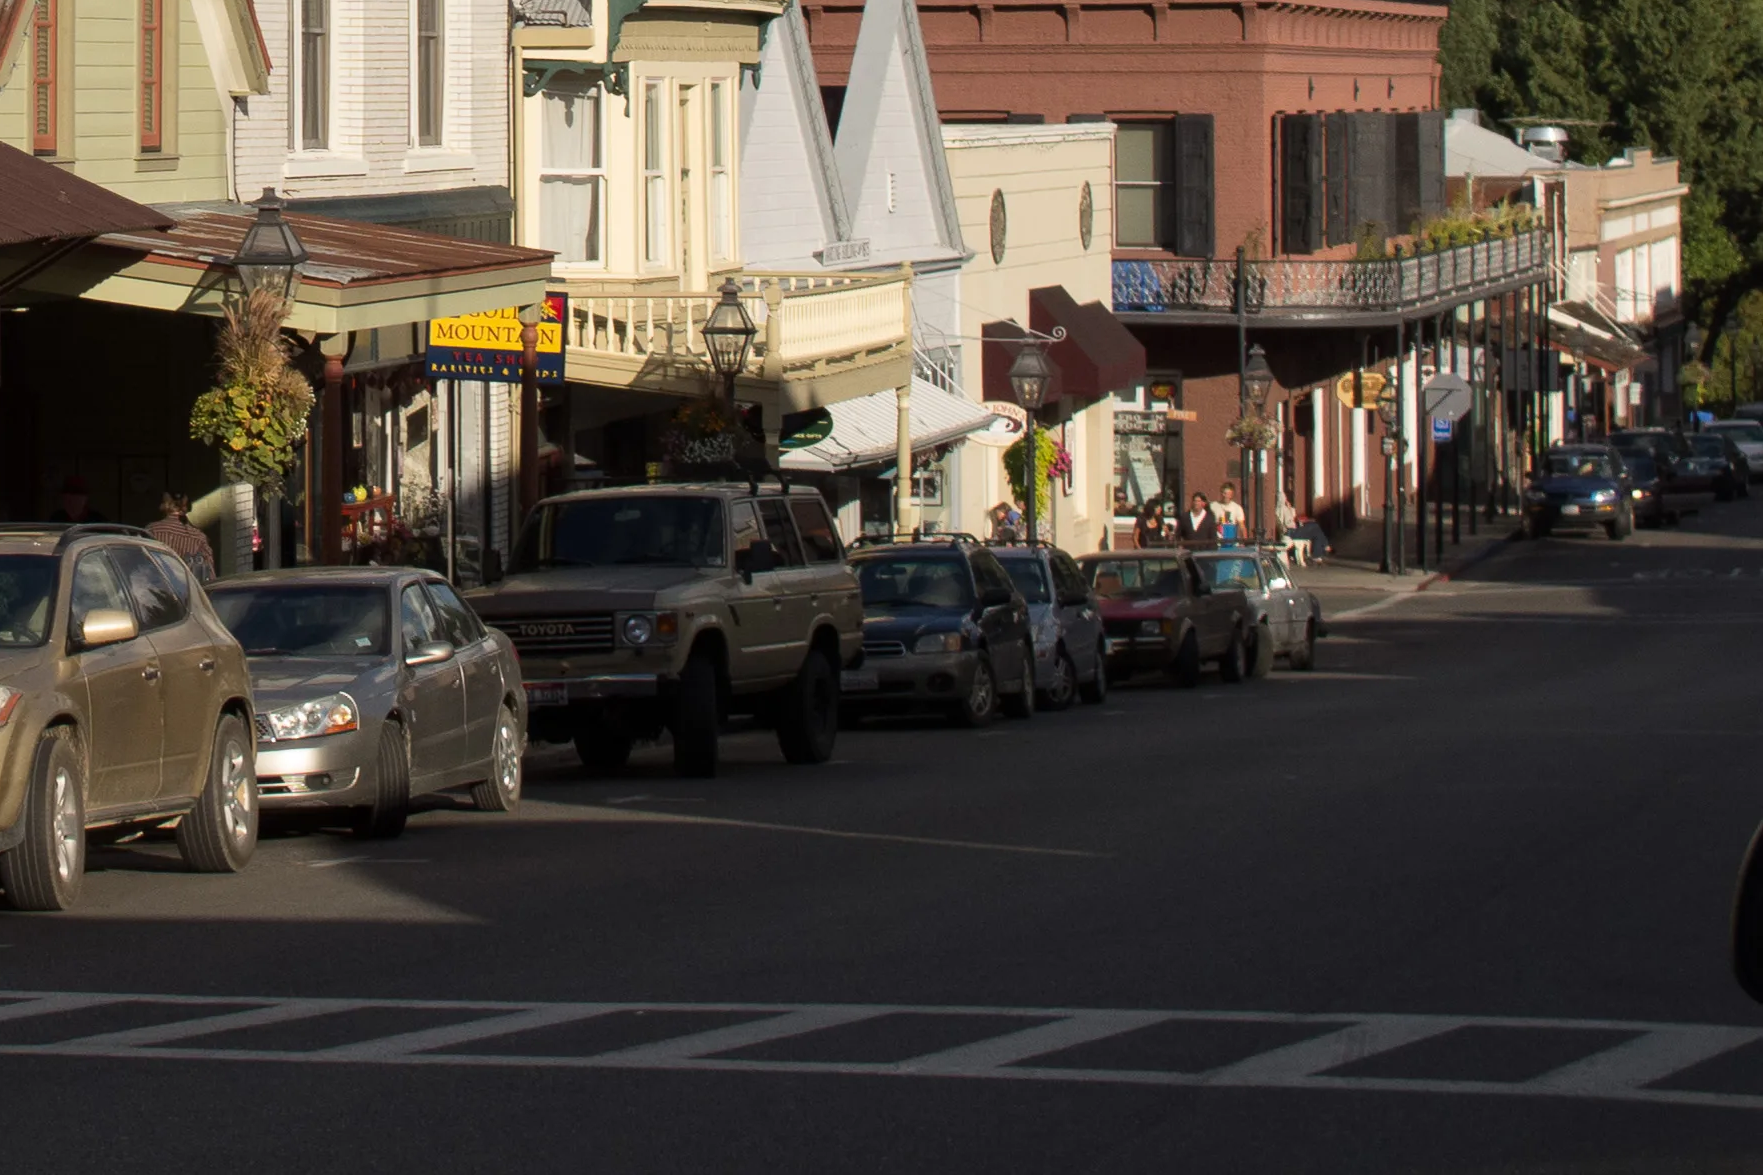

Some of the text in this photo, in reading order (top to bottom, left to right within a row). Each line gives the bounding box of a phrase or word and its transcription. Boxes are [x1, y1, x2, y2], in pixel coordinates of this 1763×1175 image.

[437, 323, 555, 345] MOUNTN
[453, 351, 484, 364] TEA
[519, 624, 575, 636] TOYOTA
